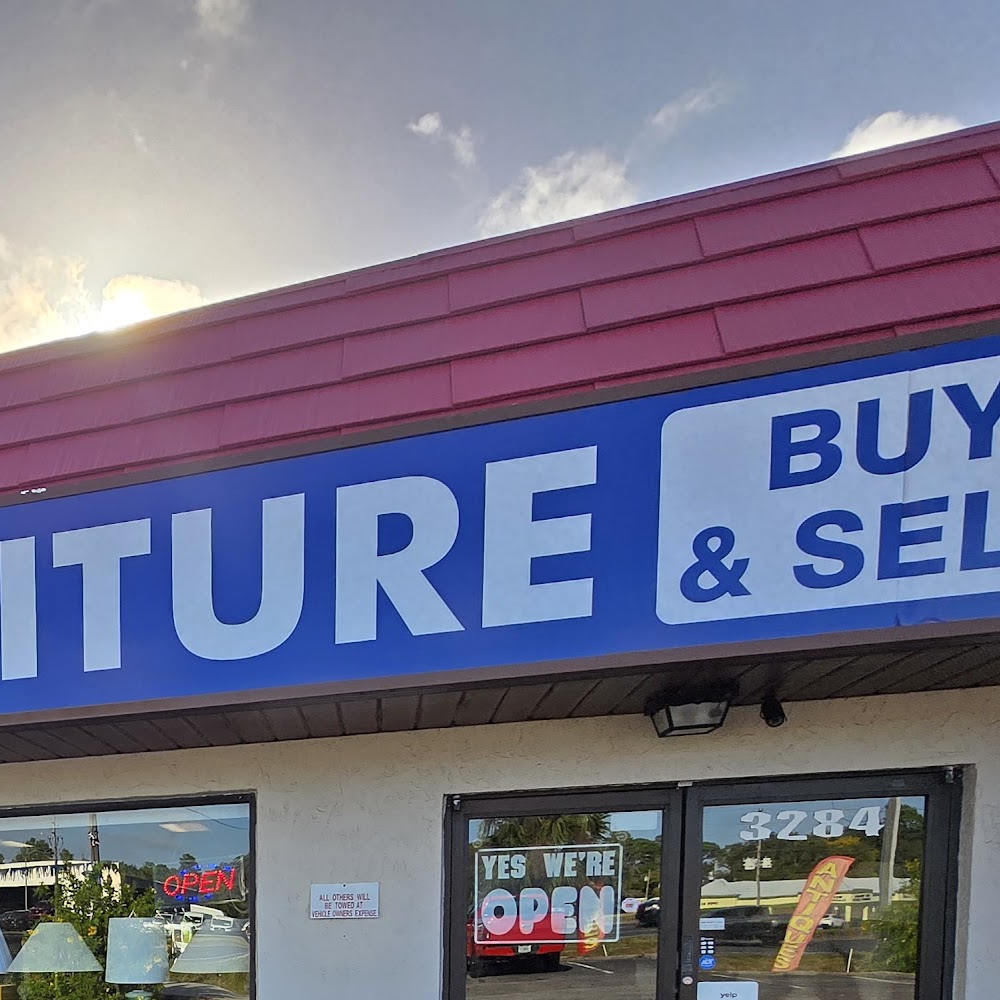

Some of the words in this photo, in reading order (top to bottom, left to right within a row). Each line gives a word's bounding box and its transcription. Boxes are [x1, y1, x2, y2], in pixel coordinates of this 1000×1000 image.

[769, 379, 1000, 490] BUY
[680, 525, 752, 603] &
[740, 806, 885, 841] 3284
[481, 853, 527, 880] YES
[542, 850, 616, 878] WE'RE
[163, 867, 236, 897] OPEN
[332, 893, 354, 901] OTHERS
[357, 893, 370, 901] WILL
[335, 901, 354, 909] TOWED
[356, 901, 363, 909] AT
[355, 909, 377, 917] EXPENSE
[481, 885, 615, 936] OPEN
[773, 862, 838, 969] ANTIQUES
